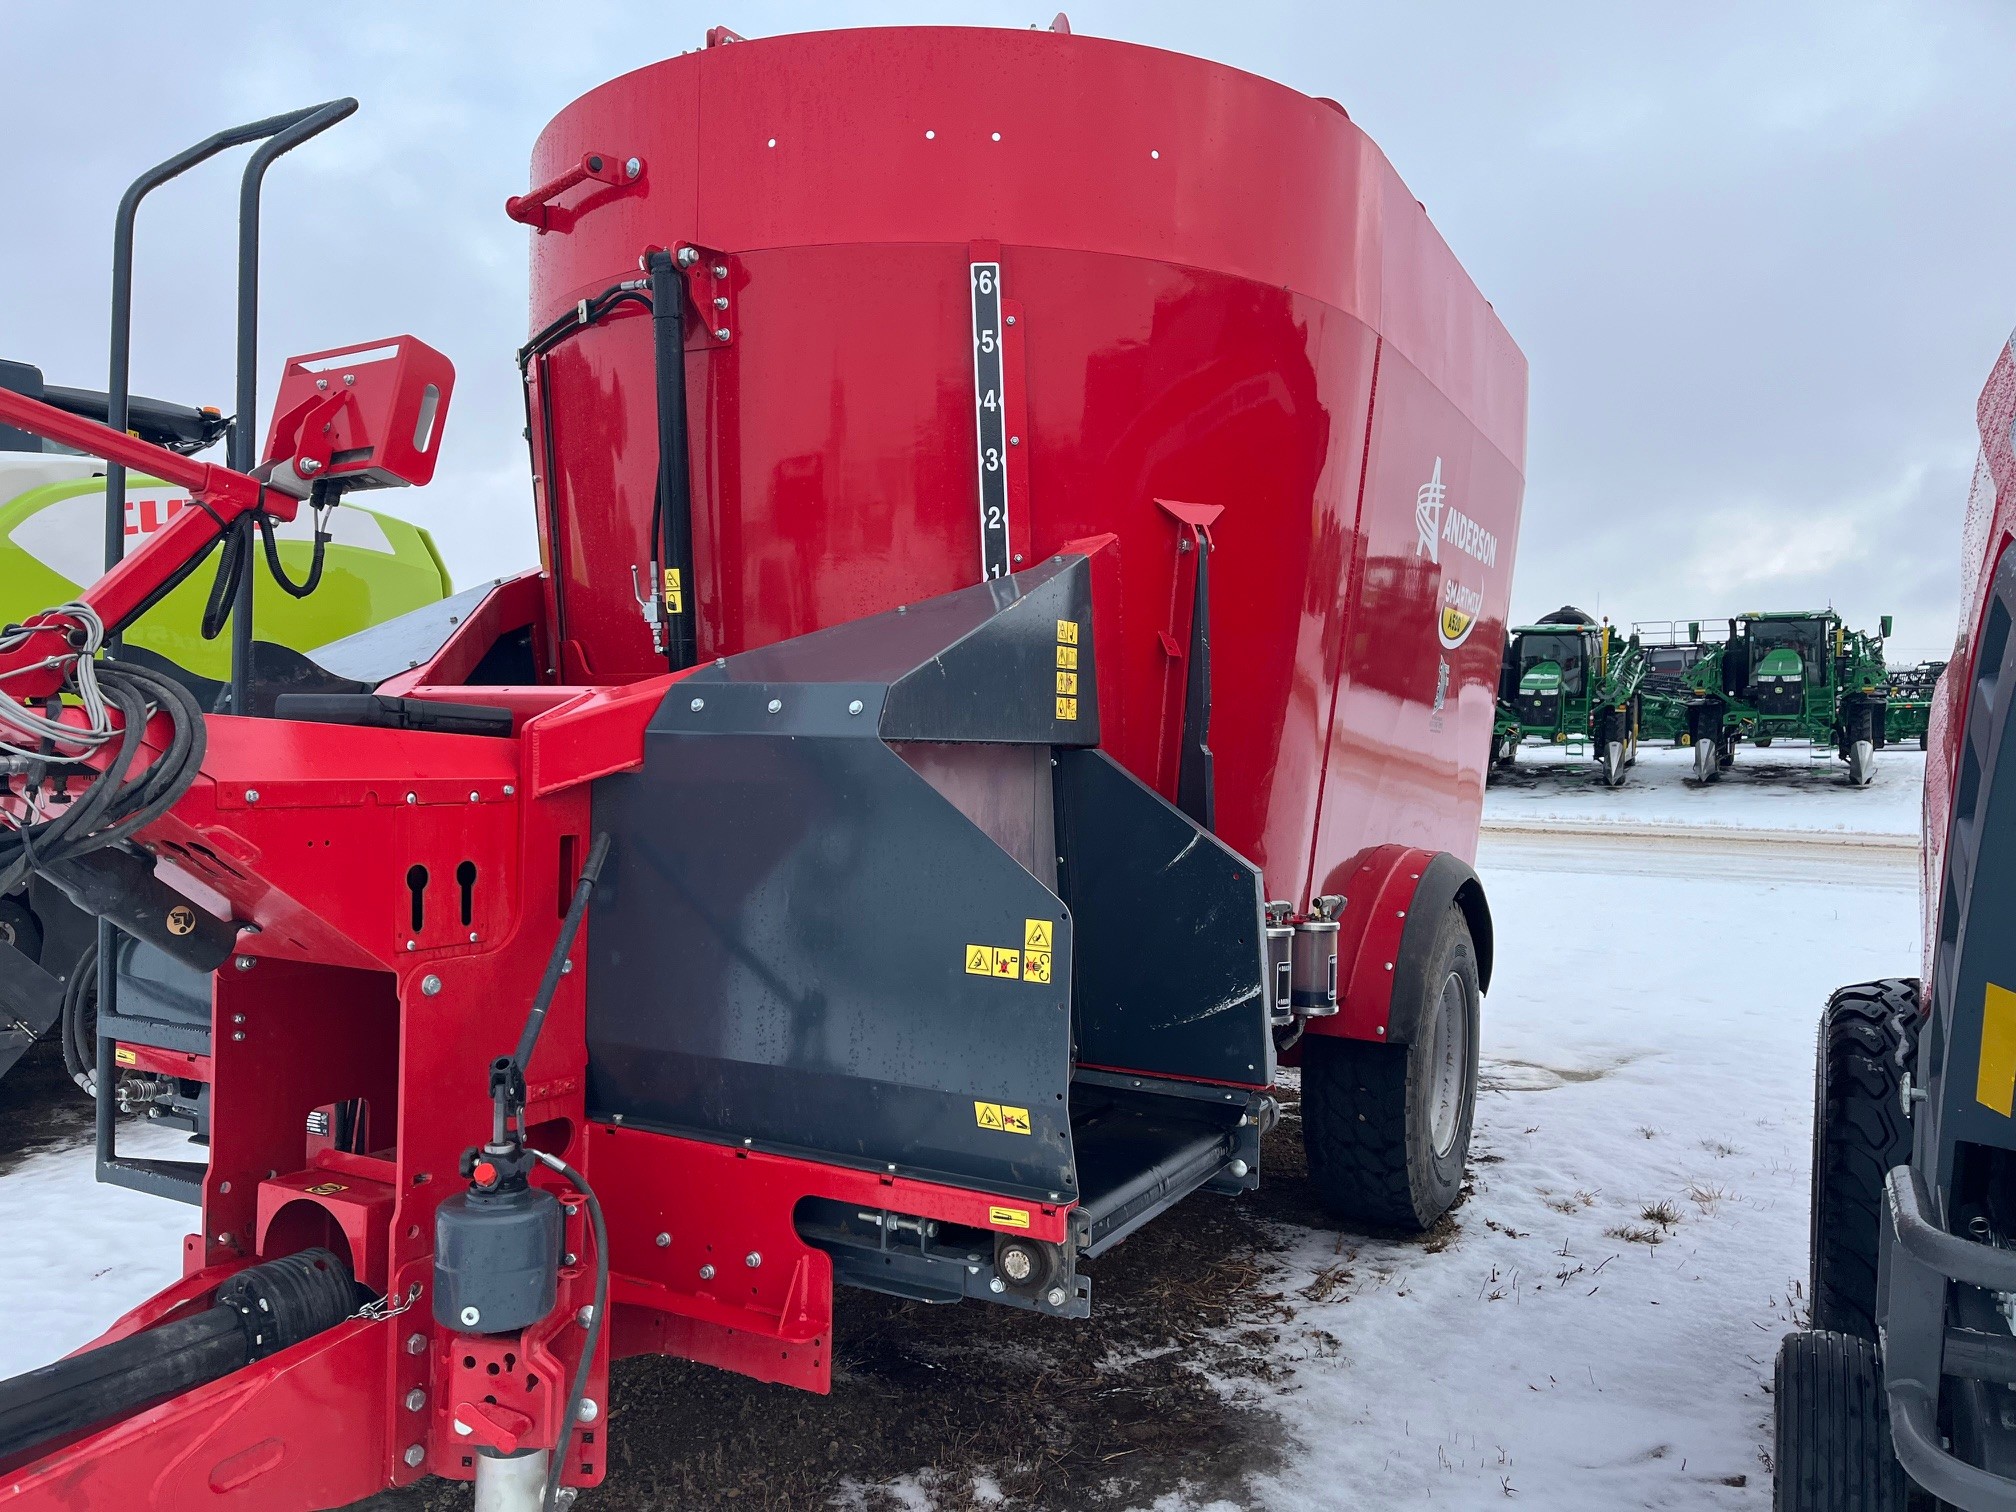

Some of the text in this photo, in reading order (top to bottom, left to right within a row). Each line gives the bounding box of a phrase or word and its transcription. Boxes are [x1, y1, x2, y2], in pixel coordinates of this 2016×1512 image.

[979, 270, 993, 295] 6
[981, 329, 995, 354] 5
[983, 389, 997, 412] 4
[985, 447, 999, 472] 3
[988, 505, 1001, 529] 2
[1441, 506, 1498, 569] ANDERSON
[990, 563, 1000, 580] 1
[1445, 579, 1480, 614] SMARTMIX
